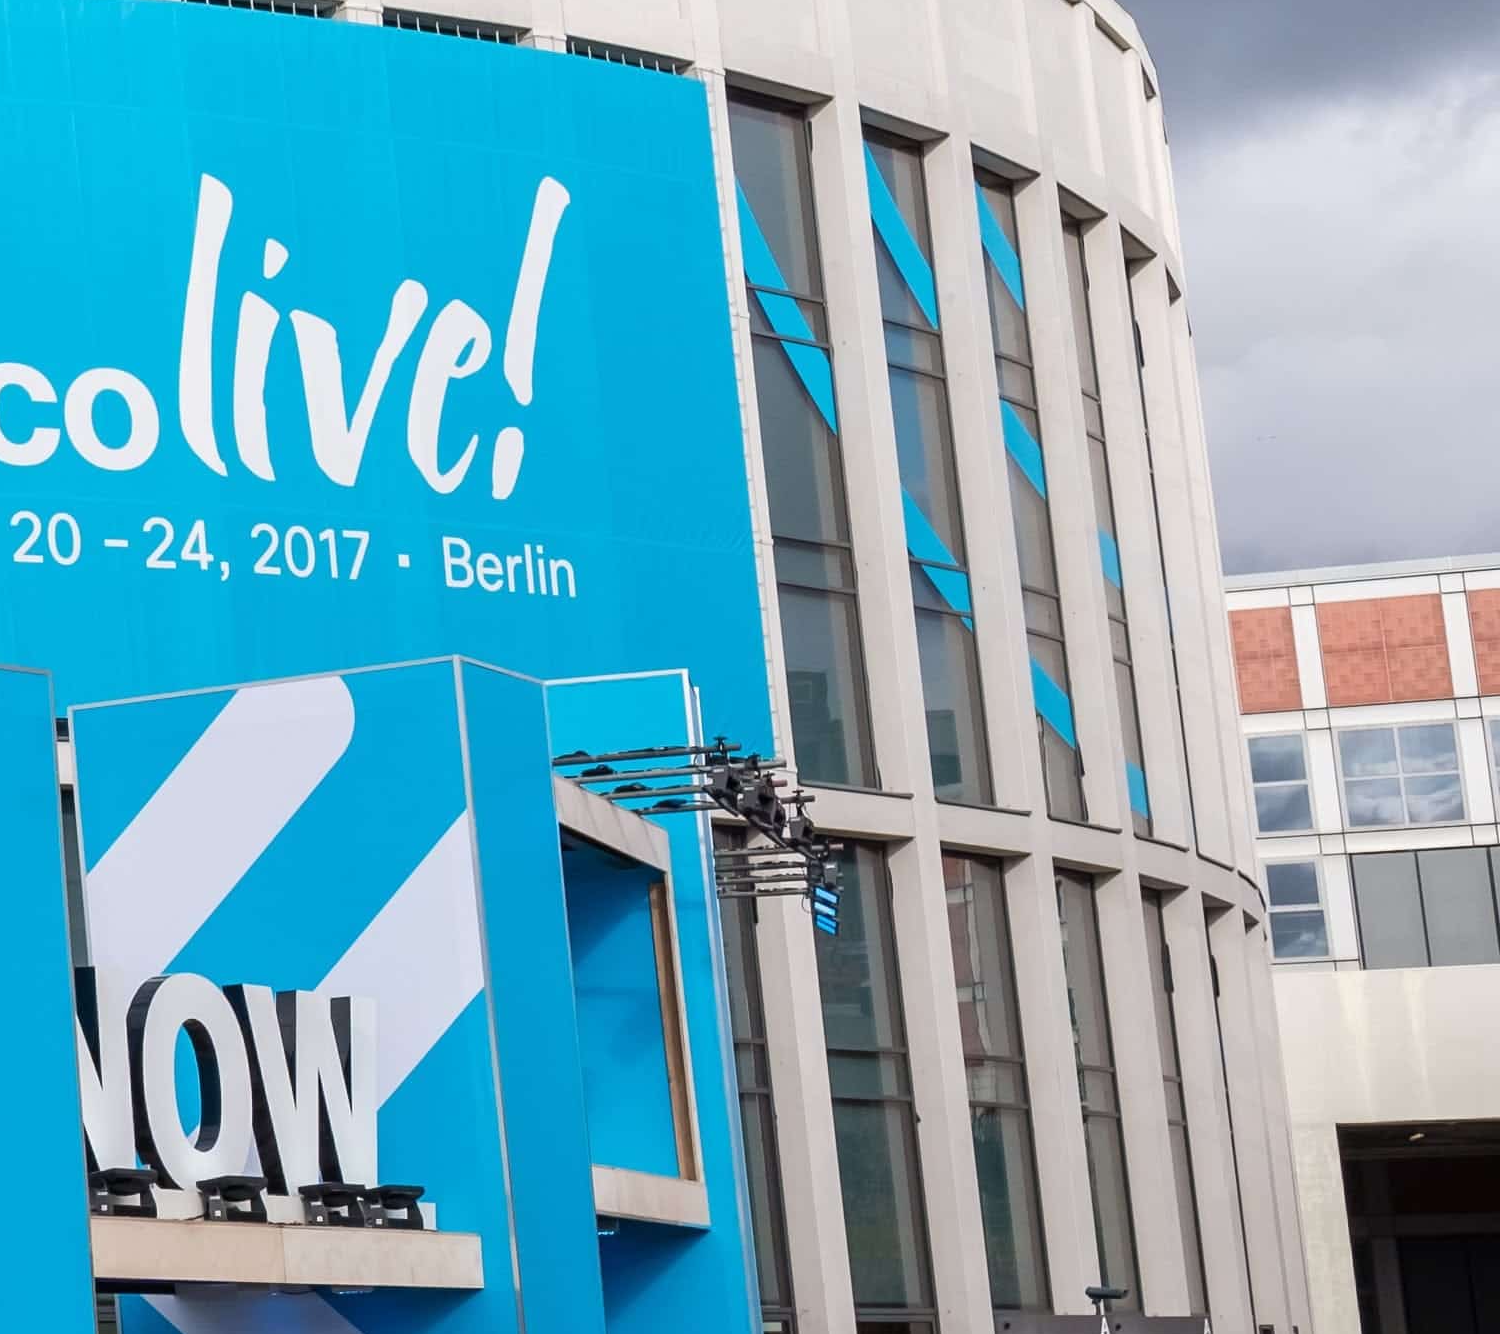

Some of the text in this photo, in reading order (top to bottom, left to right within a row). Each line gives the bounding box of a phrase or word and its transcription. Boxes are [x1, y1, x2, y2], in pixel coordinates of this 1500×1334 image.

[177, 172, 571, 500] live!
[9, 510, 82, 565] 20
[141, 517, 231, 577] 24,
[252, 523, 371, 581] 2017
[442, 536, 578, 597] Berlin
